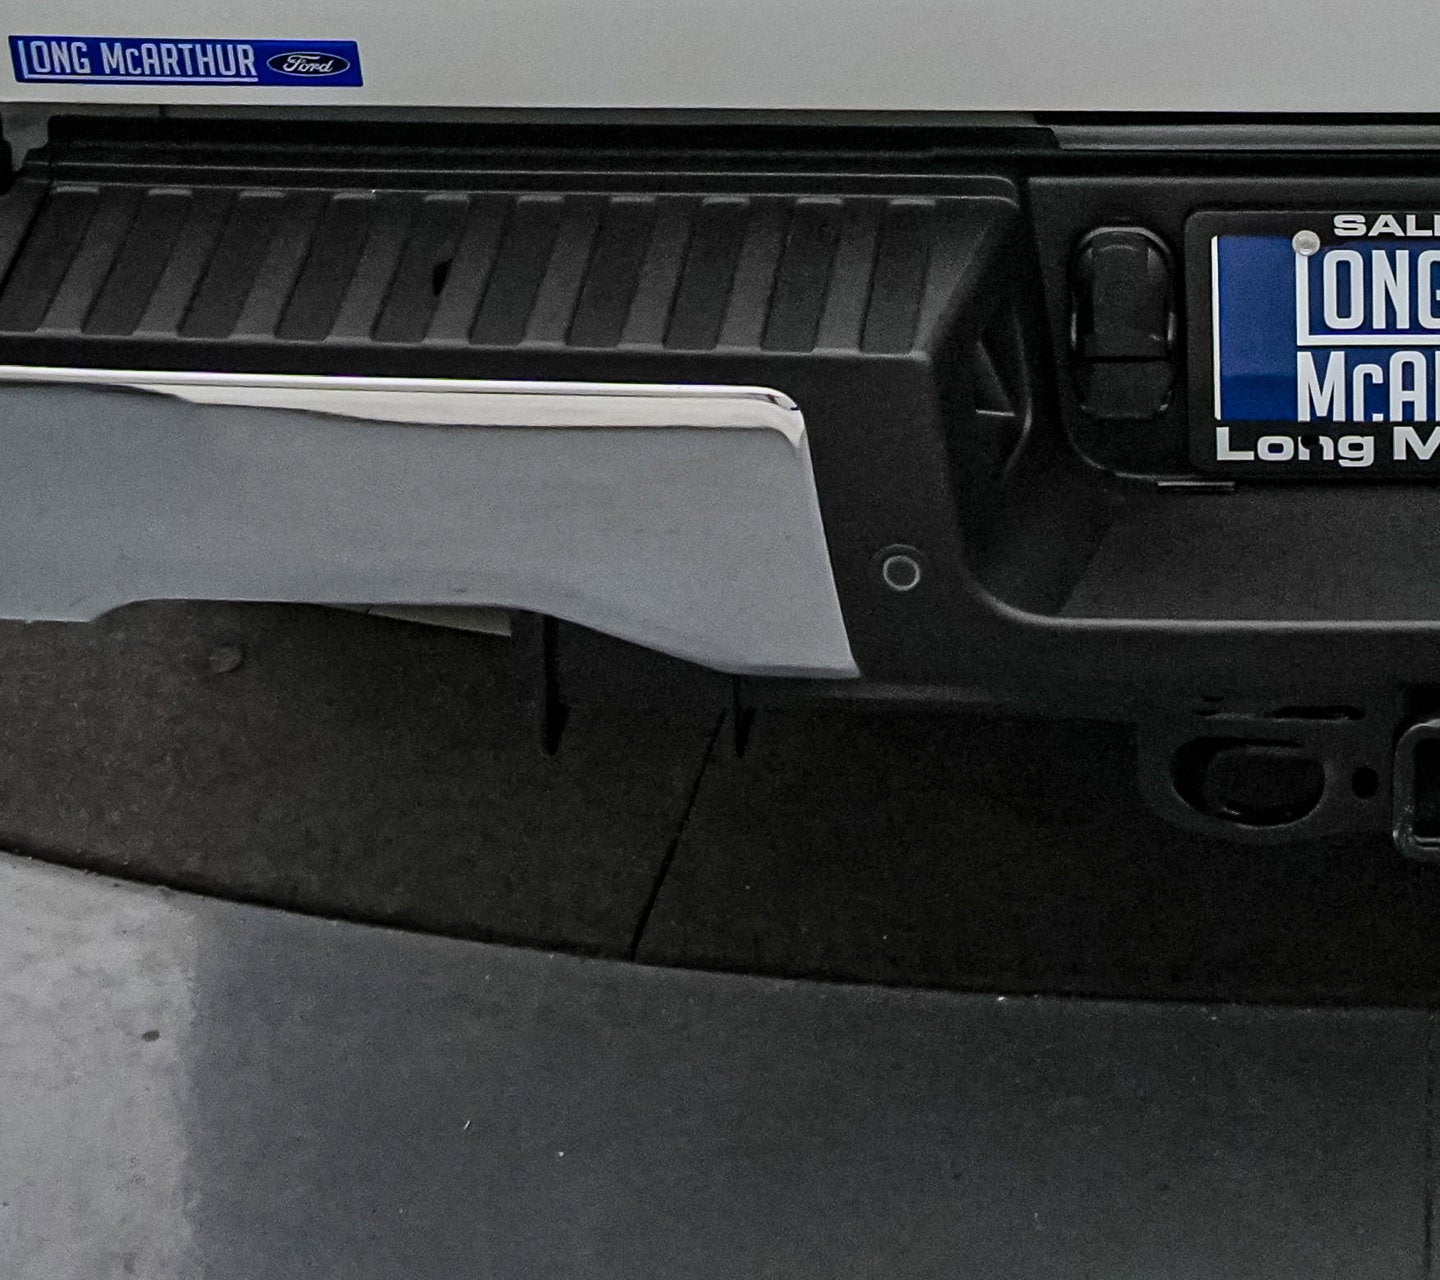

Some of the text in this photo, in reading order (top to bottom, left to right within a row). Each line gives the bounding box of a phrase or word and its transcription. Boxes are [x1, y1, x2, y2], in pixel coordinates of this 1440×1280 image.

[17, 39, 258, 78] LONG McARTHUR
[282, 52, 335, 74] Ford
[1215, 426, 1375, 468] Long
